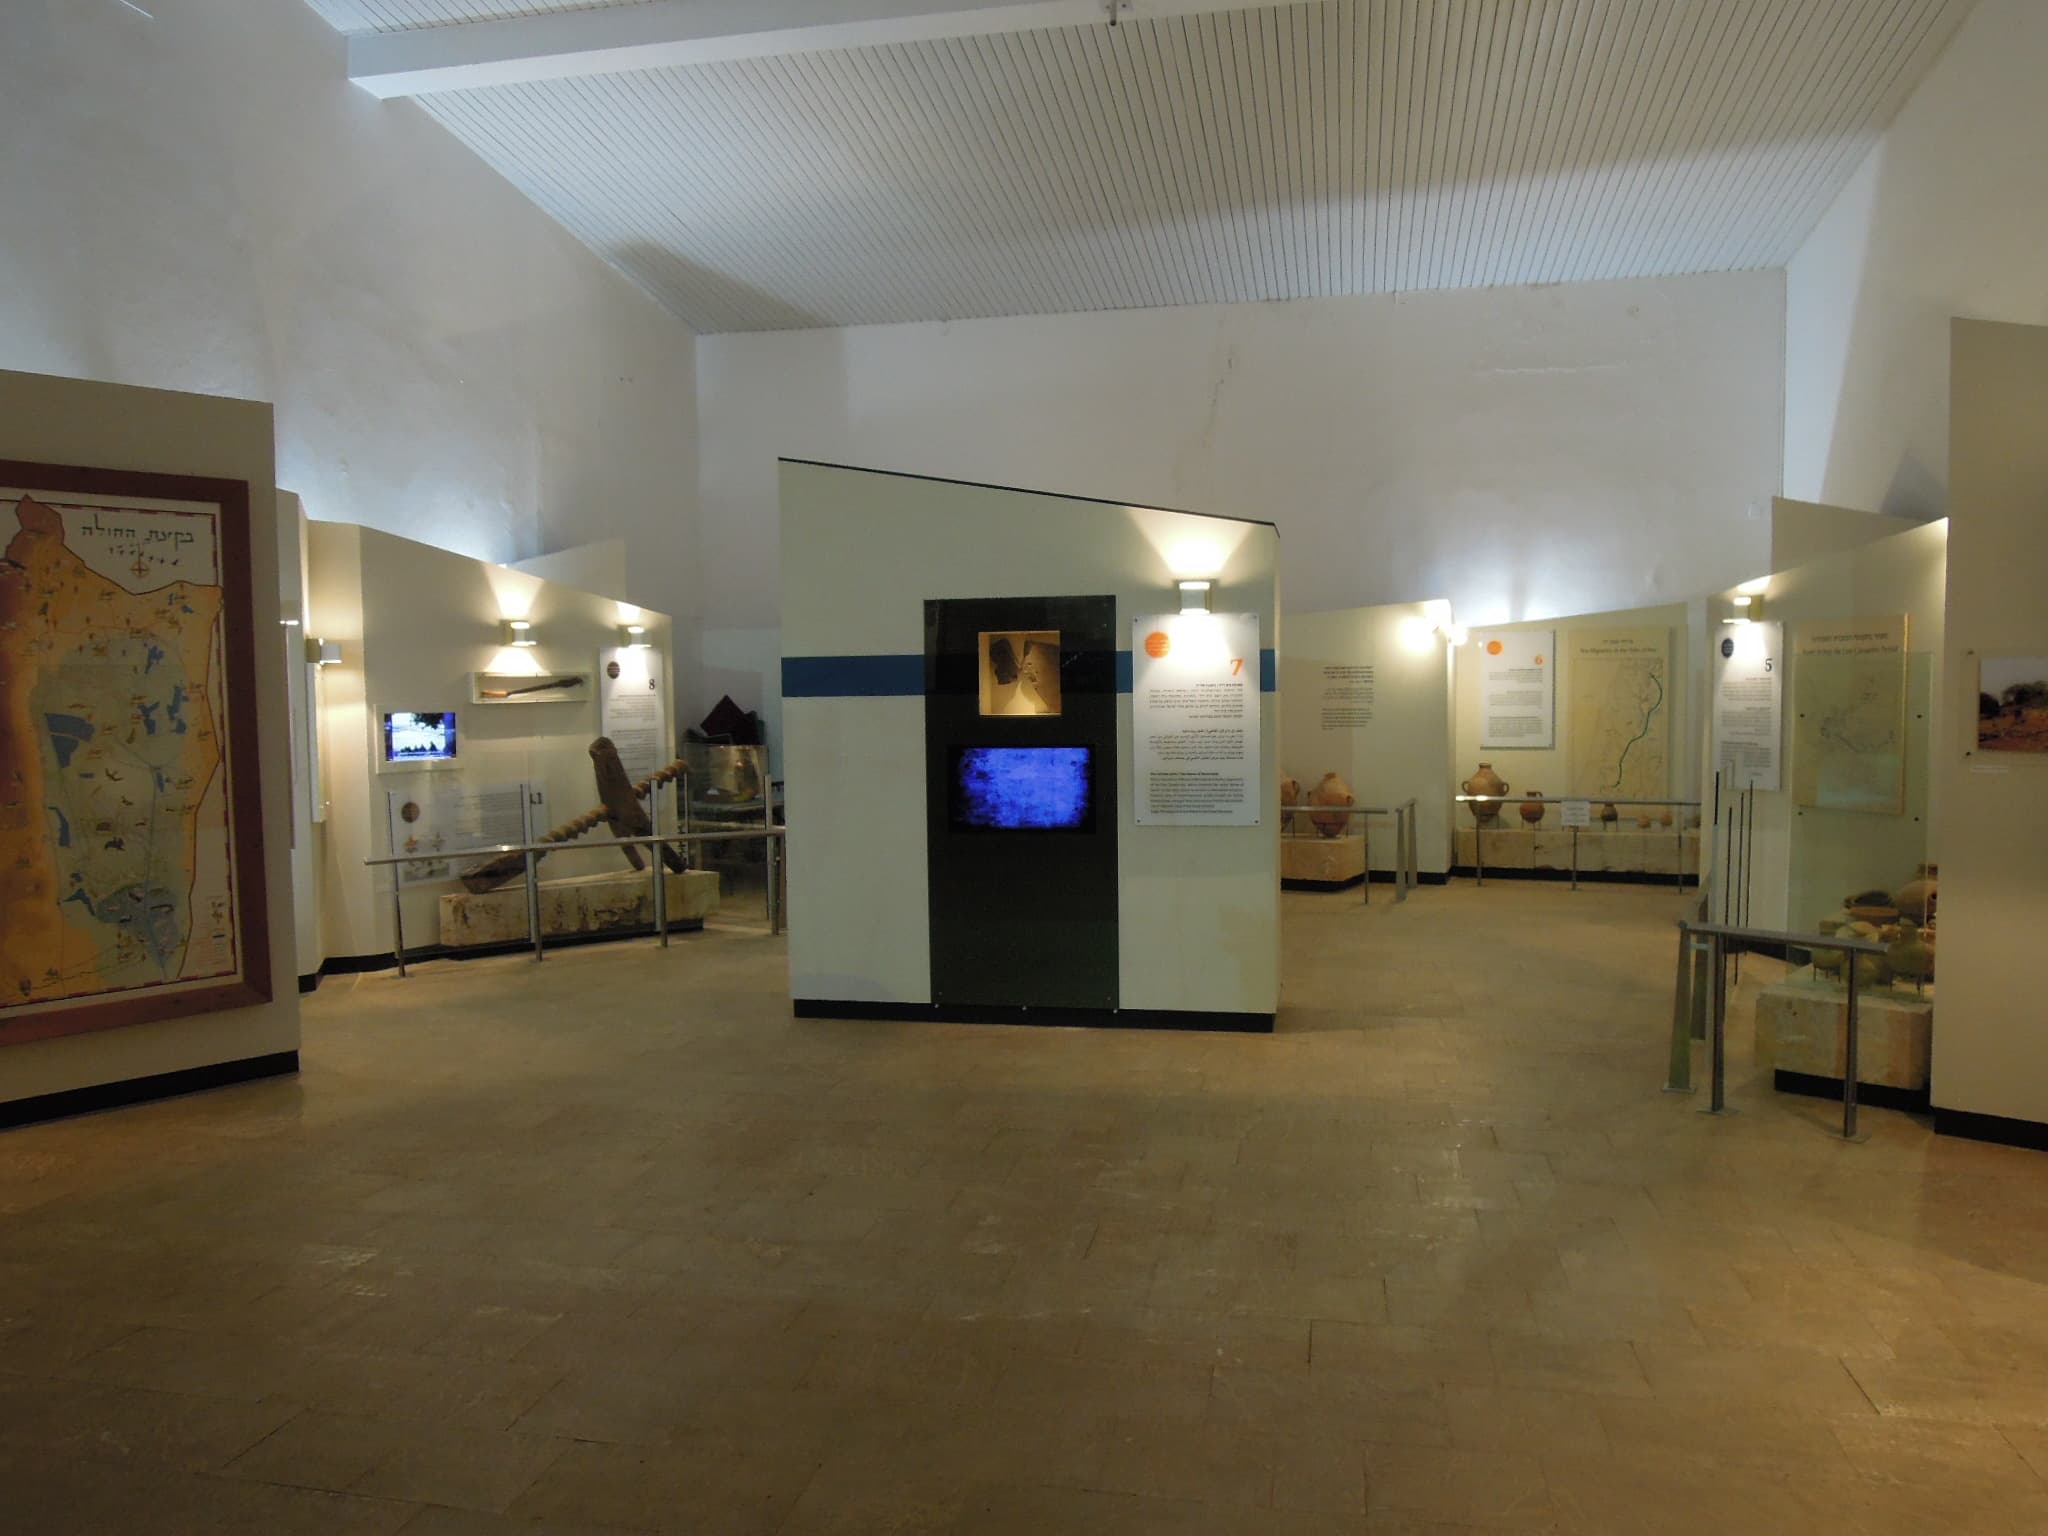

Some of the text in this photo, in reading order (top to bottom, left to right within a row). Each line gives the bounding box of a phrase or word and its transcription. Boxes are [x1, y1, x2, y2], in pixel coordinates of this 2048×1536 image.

[81, 513, 194, 552] בקעת החולה
[1230, 658, 1243, 676] 7
[1765, 658, 1773, 673] 5
[648, 678, 656, 690] 8
